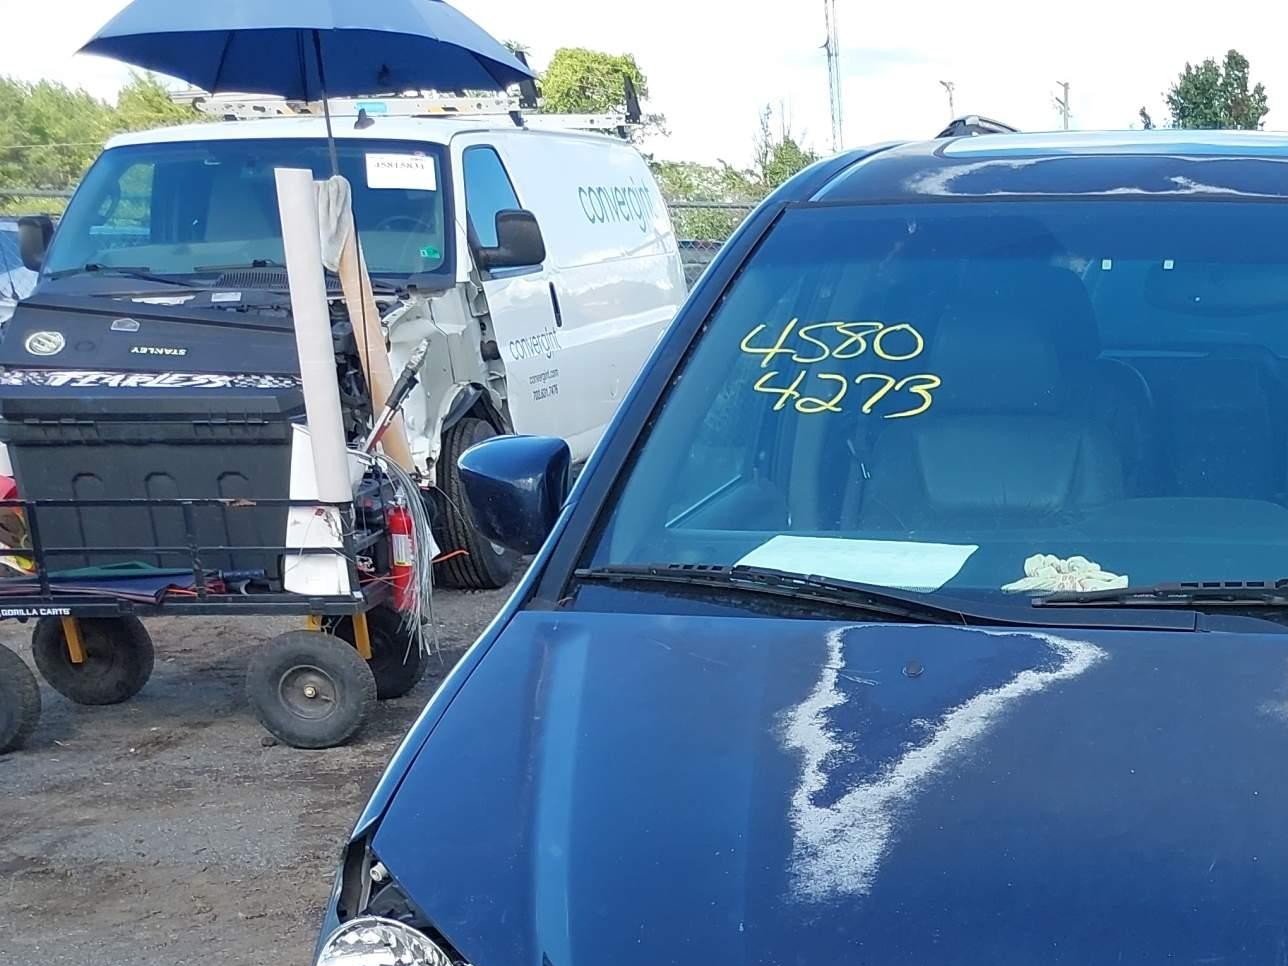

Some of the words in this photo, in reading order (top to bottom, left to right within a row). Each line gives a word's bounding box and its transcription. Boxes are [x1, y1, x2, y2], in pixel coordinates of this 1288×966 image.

[577, 176, 655, 233] convergint
[130, 345, 187, 356] STANLEY
[509, 326, 562, 360] convergint
[739, 317, 925, 368] 4580
[48, 371, 232, 388] FEARLESS
[753, 369, 942, 419] 4273
[1, 608, 38, 617] GORILLA
[40, 607, 71, 616] CARTS
